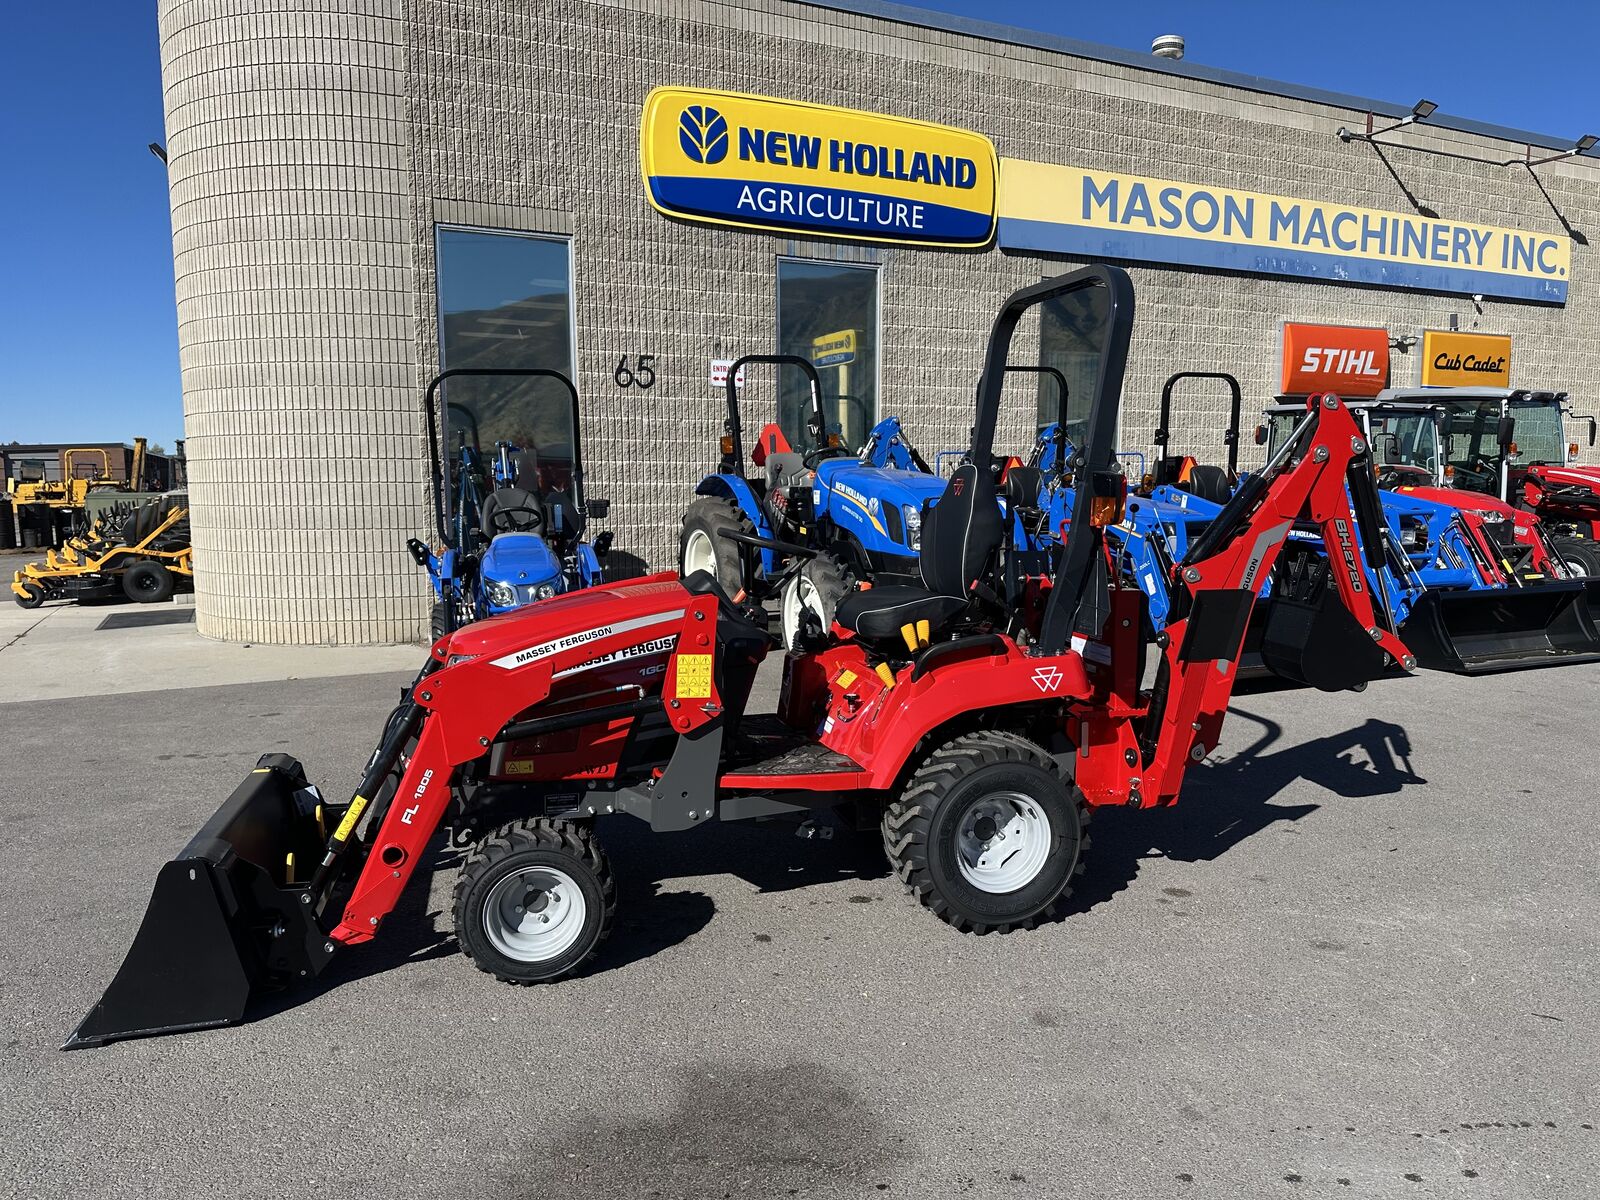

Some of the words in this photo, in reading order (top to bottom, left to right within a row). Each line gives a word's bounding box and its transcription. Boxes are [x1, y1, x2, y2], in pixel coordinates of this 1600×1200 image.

[739, 126, 821, 169] NEW
[829, 139, 977, 189] HOLLAND
[736, 185, 924, 229] AGRICULTURE
[1082, 175, 1254, 239] MASON
[1269, 201, 1493, 266] MACHINERY
[1501, 233, 1565, 276] INC.
[615, 354, 656, 389] 65
[712, 364, 742, 373] ENTRE
[1300, 347, 1380, 376] STIHL
[1434, 352, 1461, 371] Cub
[1462, 354, 1505, 373] Cadet
[515, 643, 557, 663] MASSEY
[559, 626, 613, 648] FERGUSON
[401, 804, 420, 825] FL
[414, 769, 434, 799] 1805
